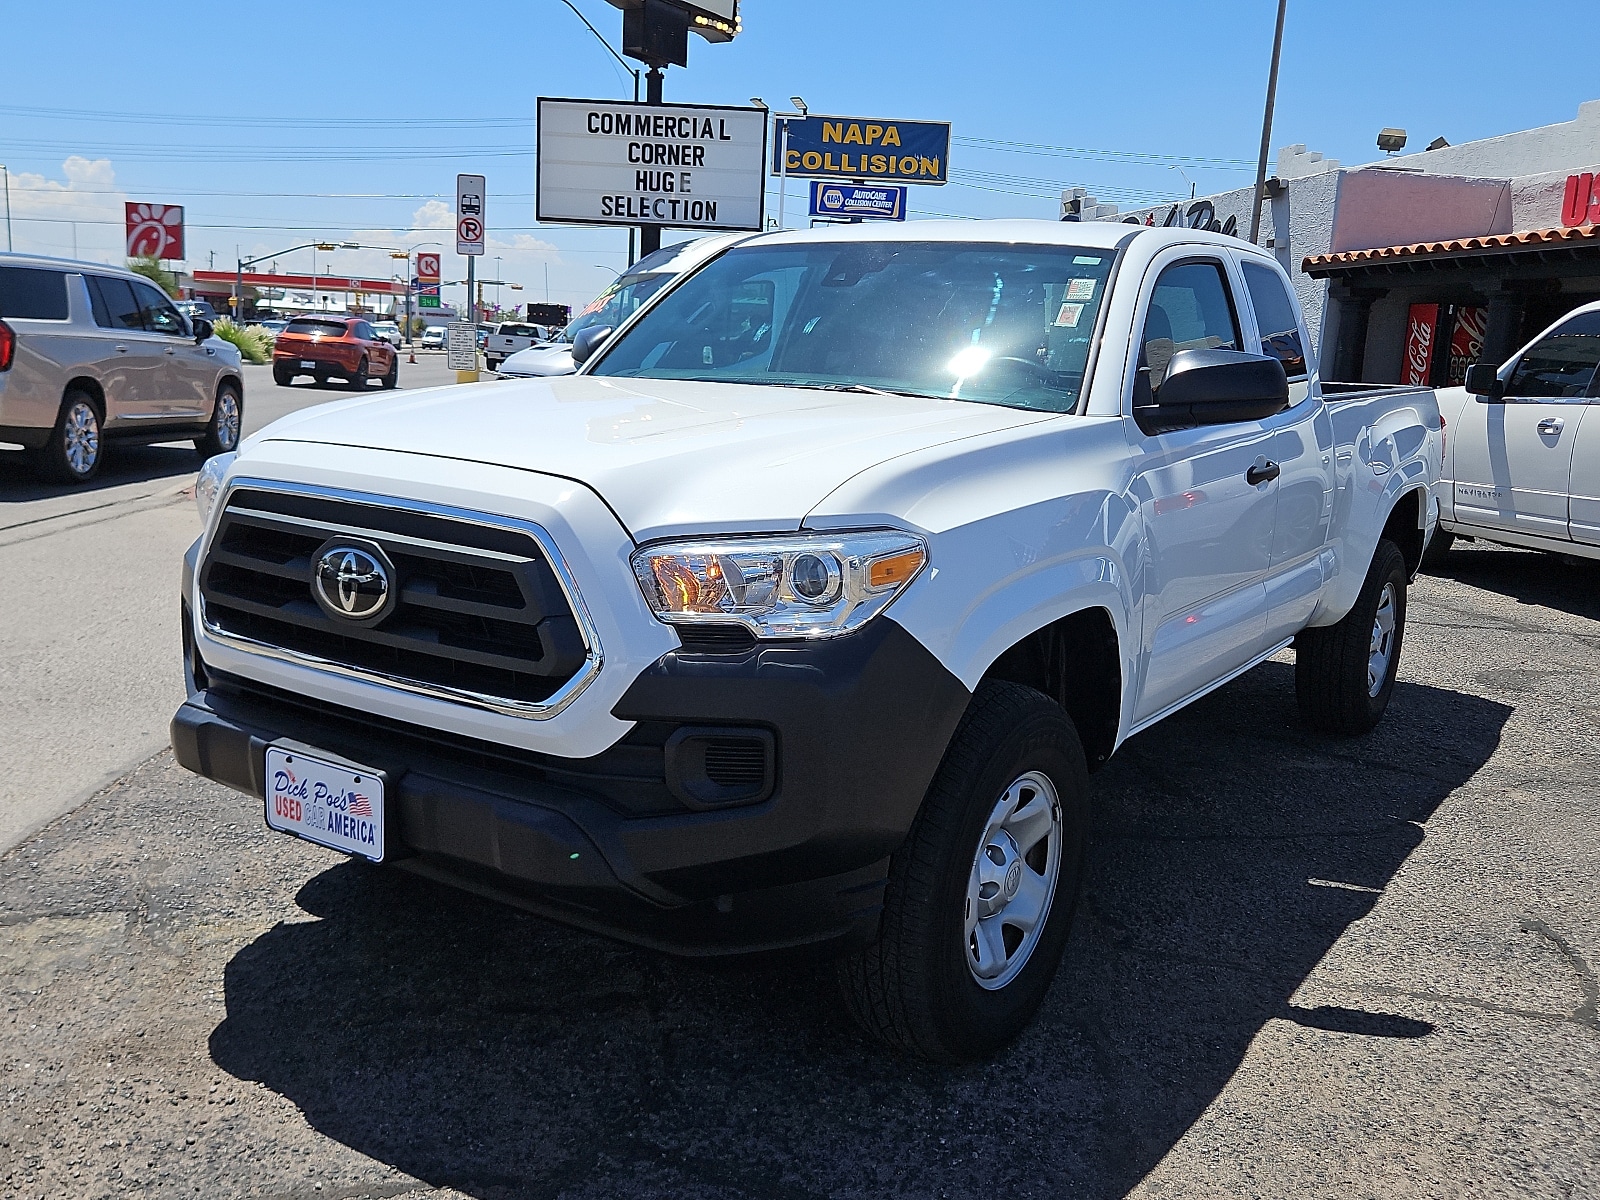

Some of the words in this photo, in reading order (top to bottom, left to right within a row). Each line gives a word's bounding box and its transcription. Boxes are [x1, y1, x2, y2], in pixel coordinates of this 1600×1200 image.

[587, 112, 731, 141] COMMERCIAL
[822, 121, 901, 147] NAPA
[628, 142, 705, 168] CORNER
[785, 150, 939, 177] COLLISION
[635, 169, 691, 193] HUGE
[601, 195, 717, 221] SELECTION
[274, 769, 308, 800] Dick
[313, 781, 349, 812] Poe's
[275, 794, 302, 822] USED
[304, 802, 326, 831] CAR
[327, 810, 375, 846] AMERICA
